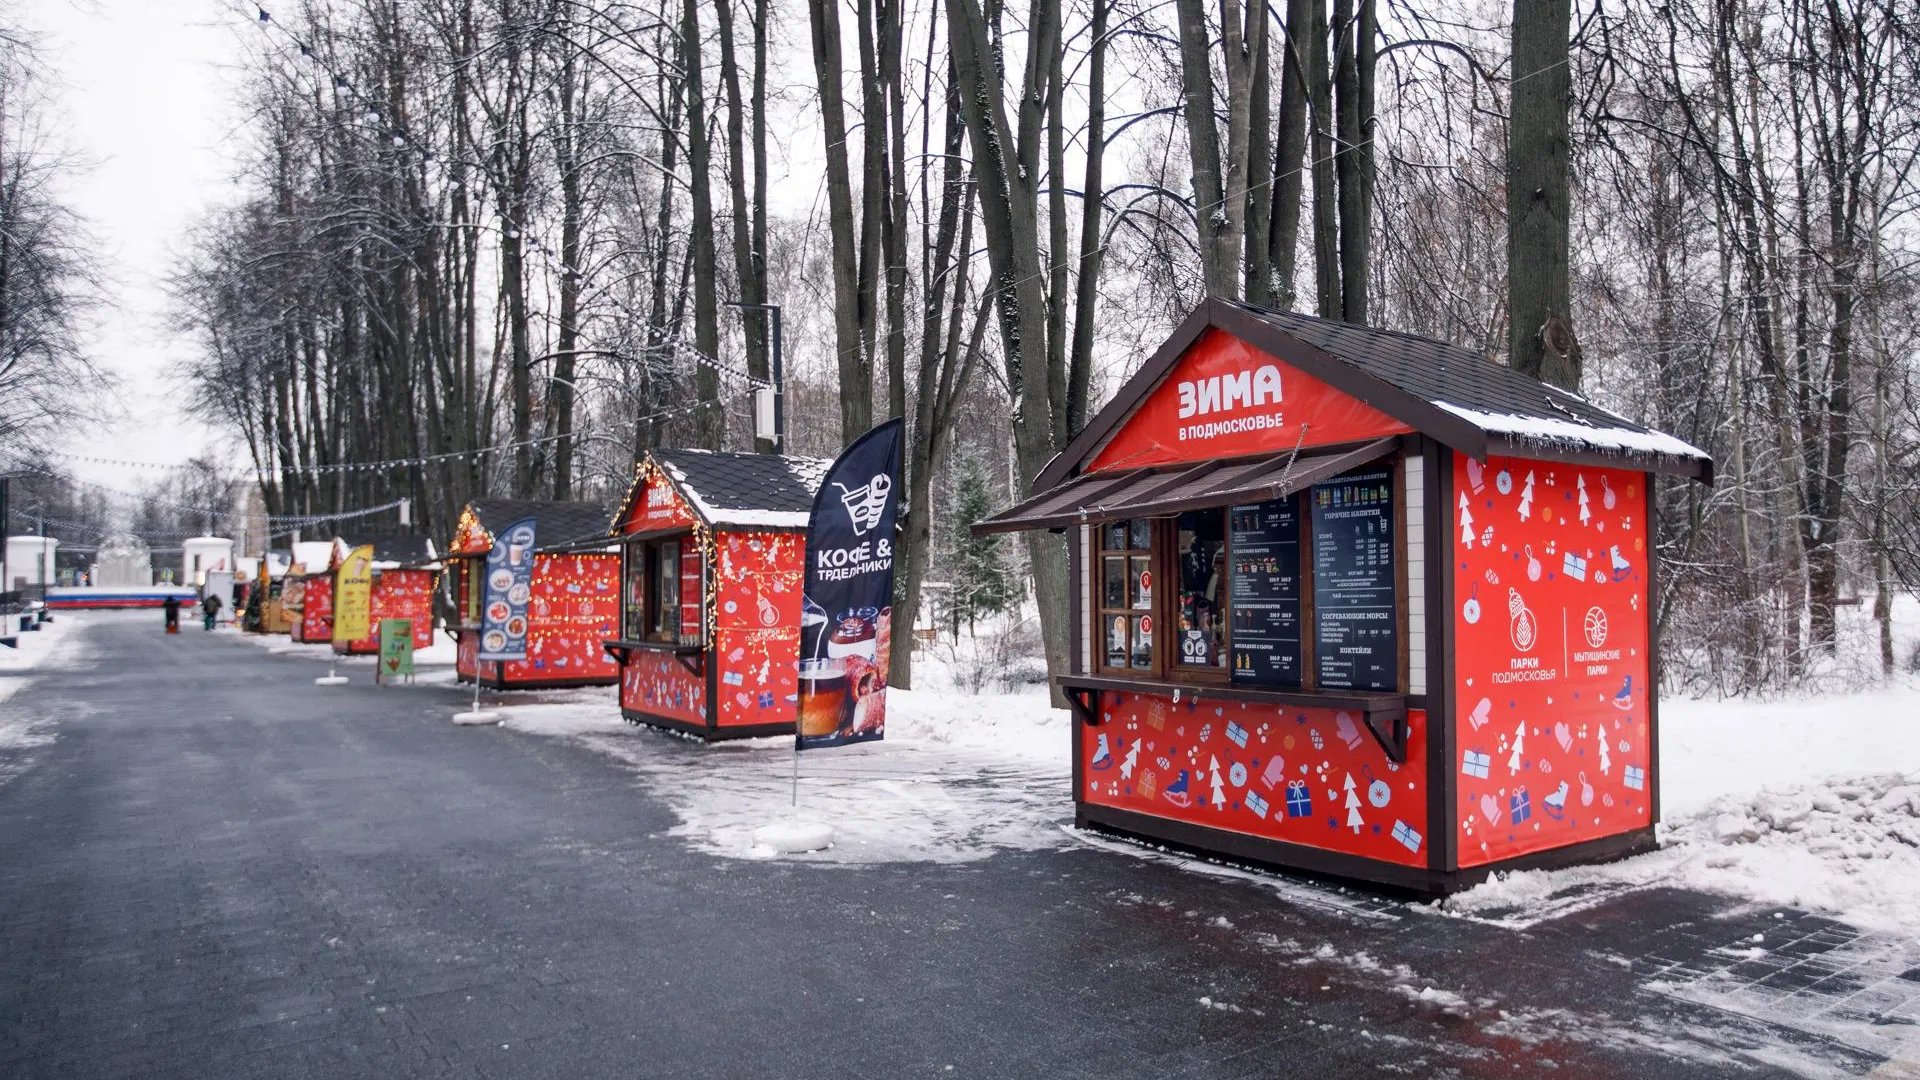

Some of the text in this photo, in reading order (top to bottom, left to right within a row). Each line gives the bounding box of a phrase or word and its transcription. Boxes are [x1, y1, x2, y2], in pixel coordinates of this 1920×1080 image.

[1178, 365, 1283, 419] ЗИМА
[1179, 413, 1283, 441] В ПОДМОСКОВЬЕ
[648, 487, 673, 508] ЗИМА
[1351, 509, 1380, 517] НАПИТКИ
[818, 538, 892, 568] КОФЕ &
[1340, 646, 1372, 654] КОКТЕЙЛИ
[1574, 650, 1620, 663] МЫТИЩИНСКИЕ
[1511, 657, 1539, 670] ПАРКИ
[1587, 665, 1608, 676] ПАРКИ
[1492, 668, 1556, 684] ПОДМОСКОВЬЯ
